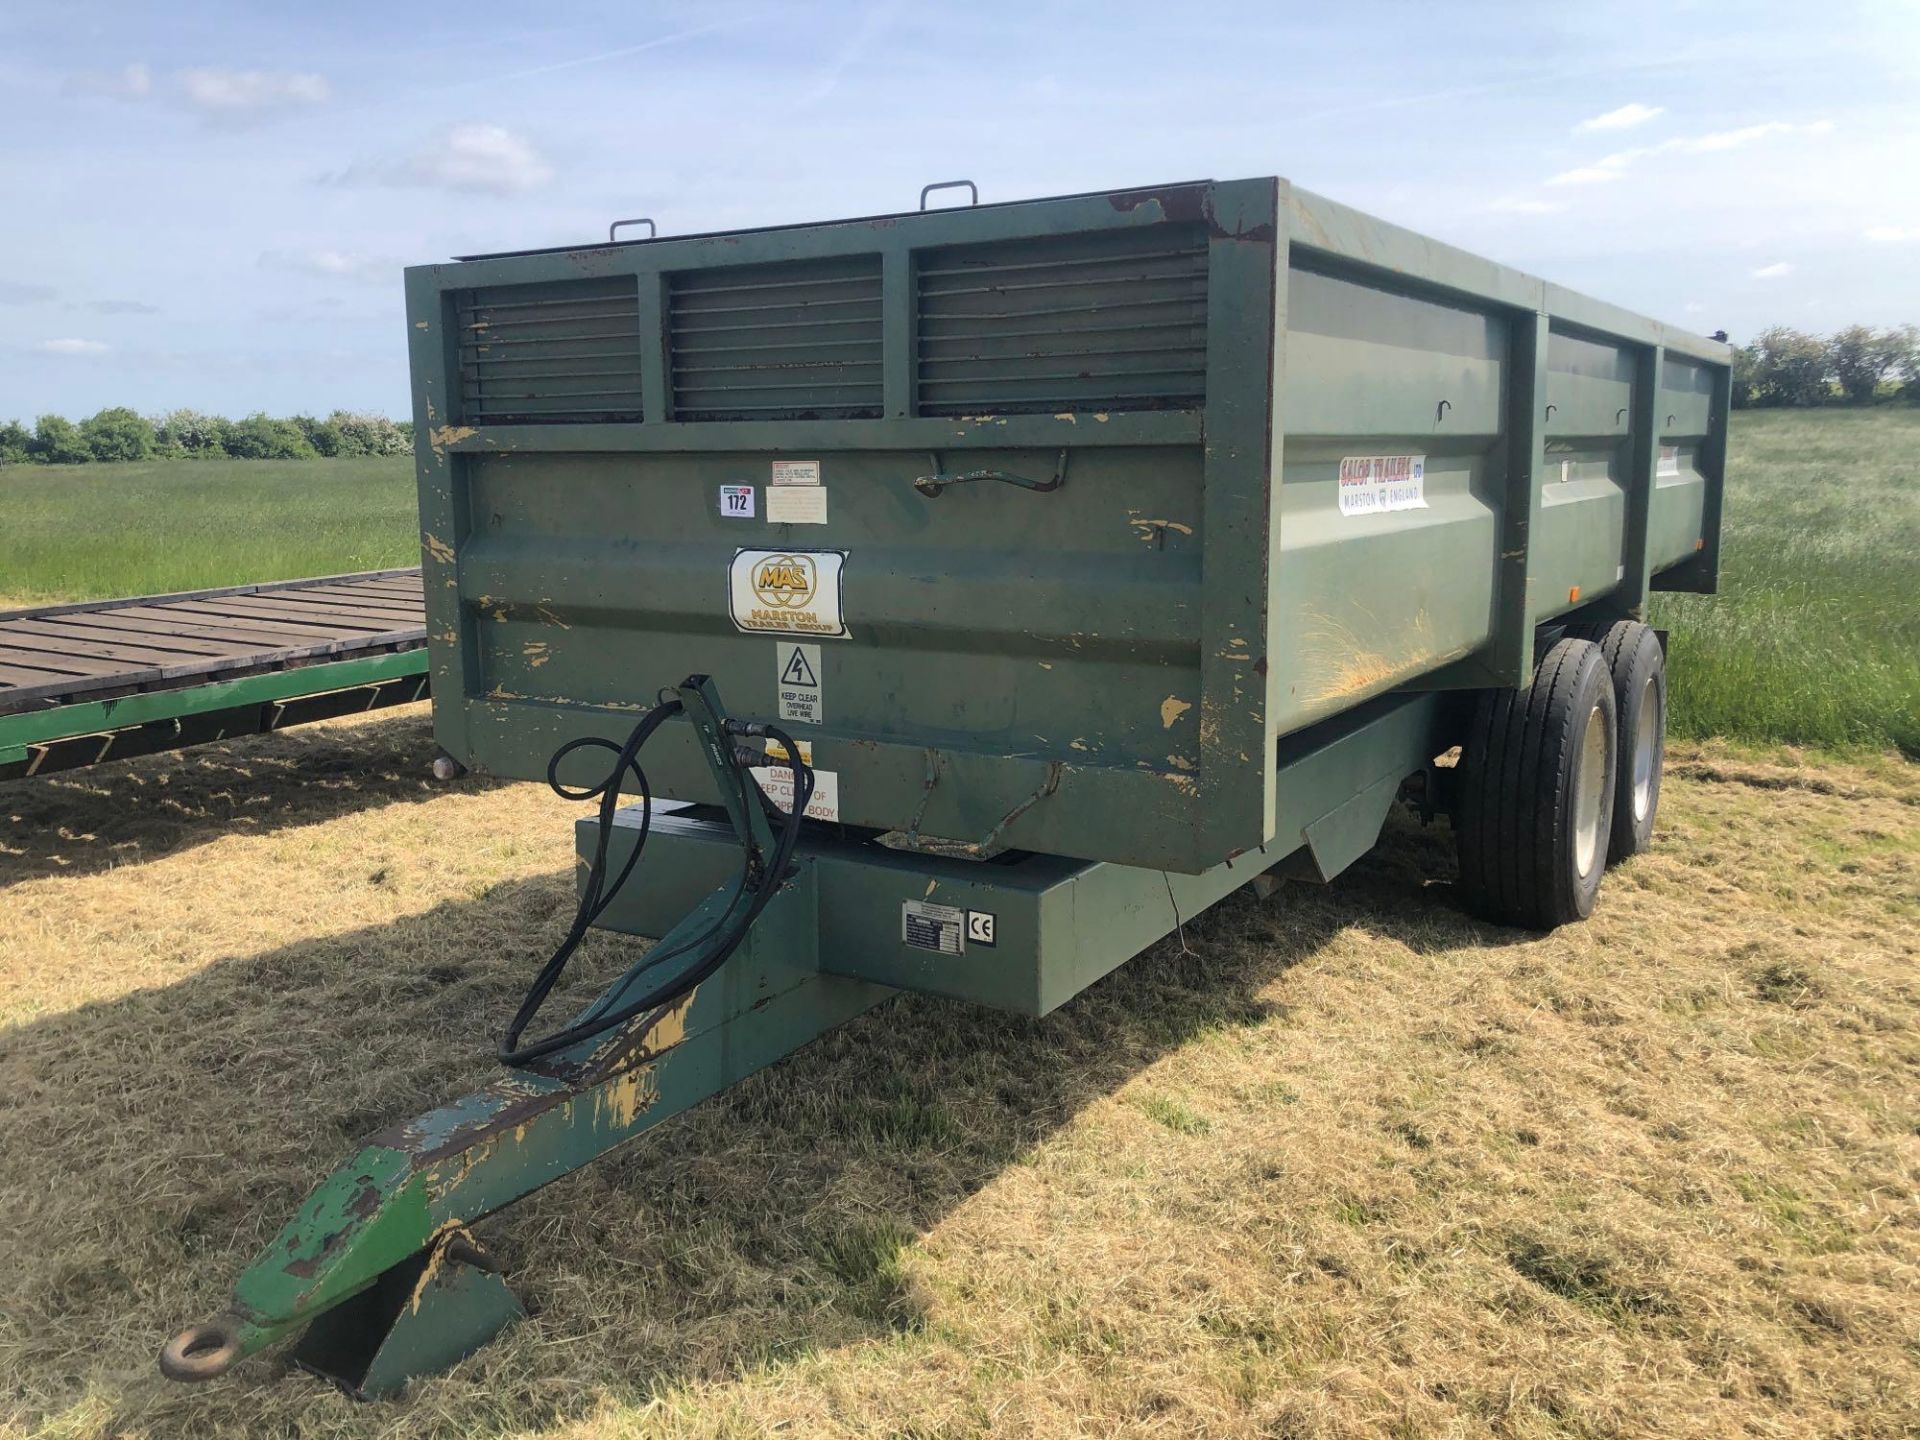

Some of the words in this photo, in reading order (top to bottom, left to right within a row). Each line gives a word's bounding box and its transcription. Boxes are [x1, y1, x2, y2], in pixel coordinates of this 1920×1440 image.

[728, 494, 747, 511] 172
[1390, 486, 1418, 504] ENGLAND
[758, 566, 808, 590] MAS
[751, 608, 817, 623] MARSTON
[743, 619, 790, 630] TRAILER
[796, 623, 833, 632] GROUP
[781, 691, 797, 701] KEEP
[798, 693, 818, 704] CLEAR
[786, 701, 812, 711] OVERHEAD
[760, 783, 777, 794] EEP
[814, 790, 827, 801] OF
[808, 805, 835, 817] BODY
